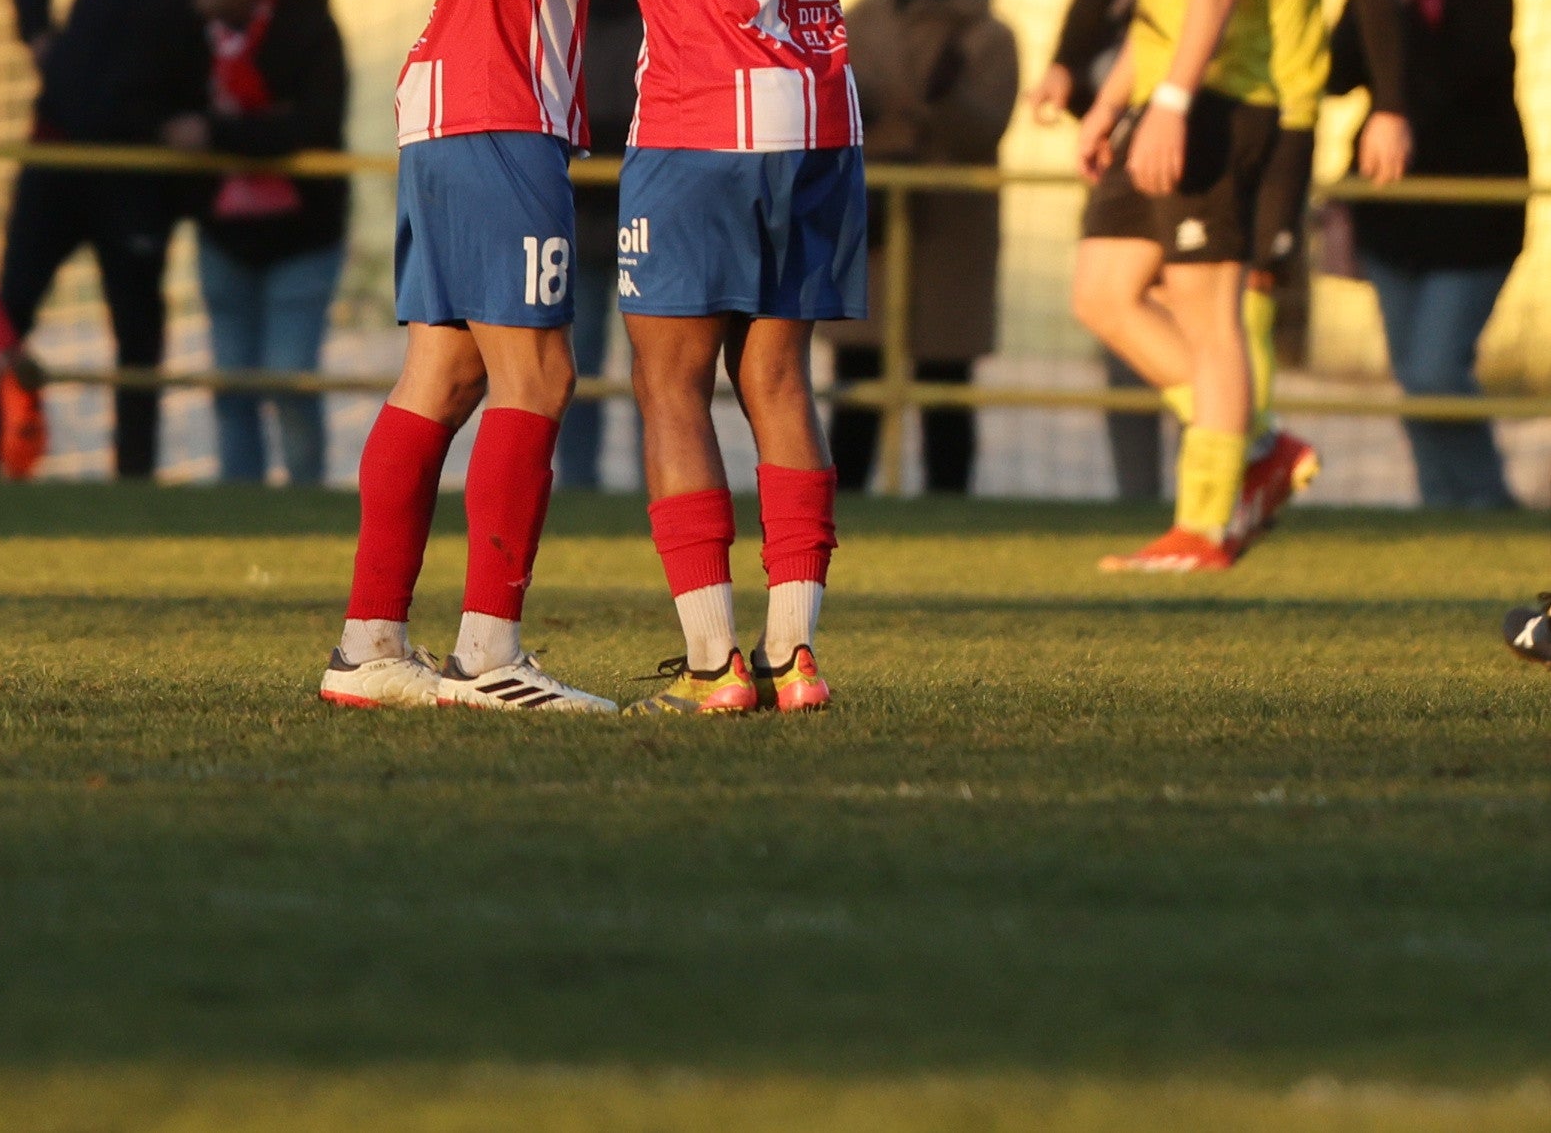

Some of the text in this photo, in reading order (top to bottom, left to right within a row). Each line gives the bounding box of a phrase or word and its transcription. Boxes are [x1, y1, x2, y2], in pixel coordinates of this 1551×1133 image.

[802, 29, 824, 47] EL
[618, 217, 649, 255] oil
[522, 236, 570, 306] 18
